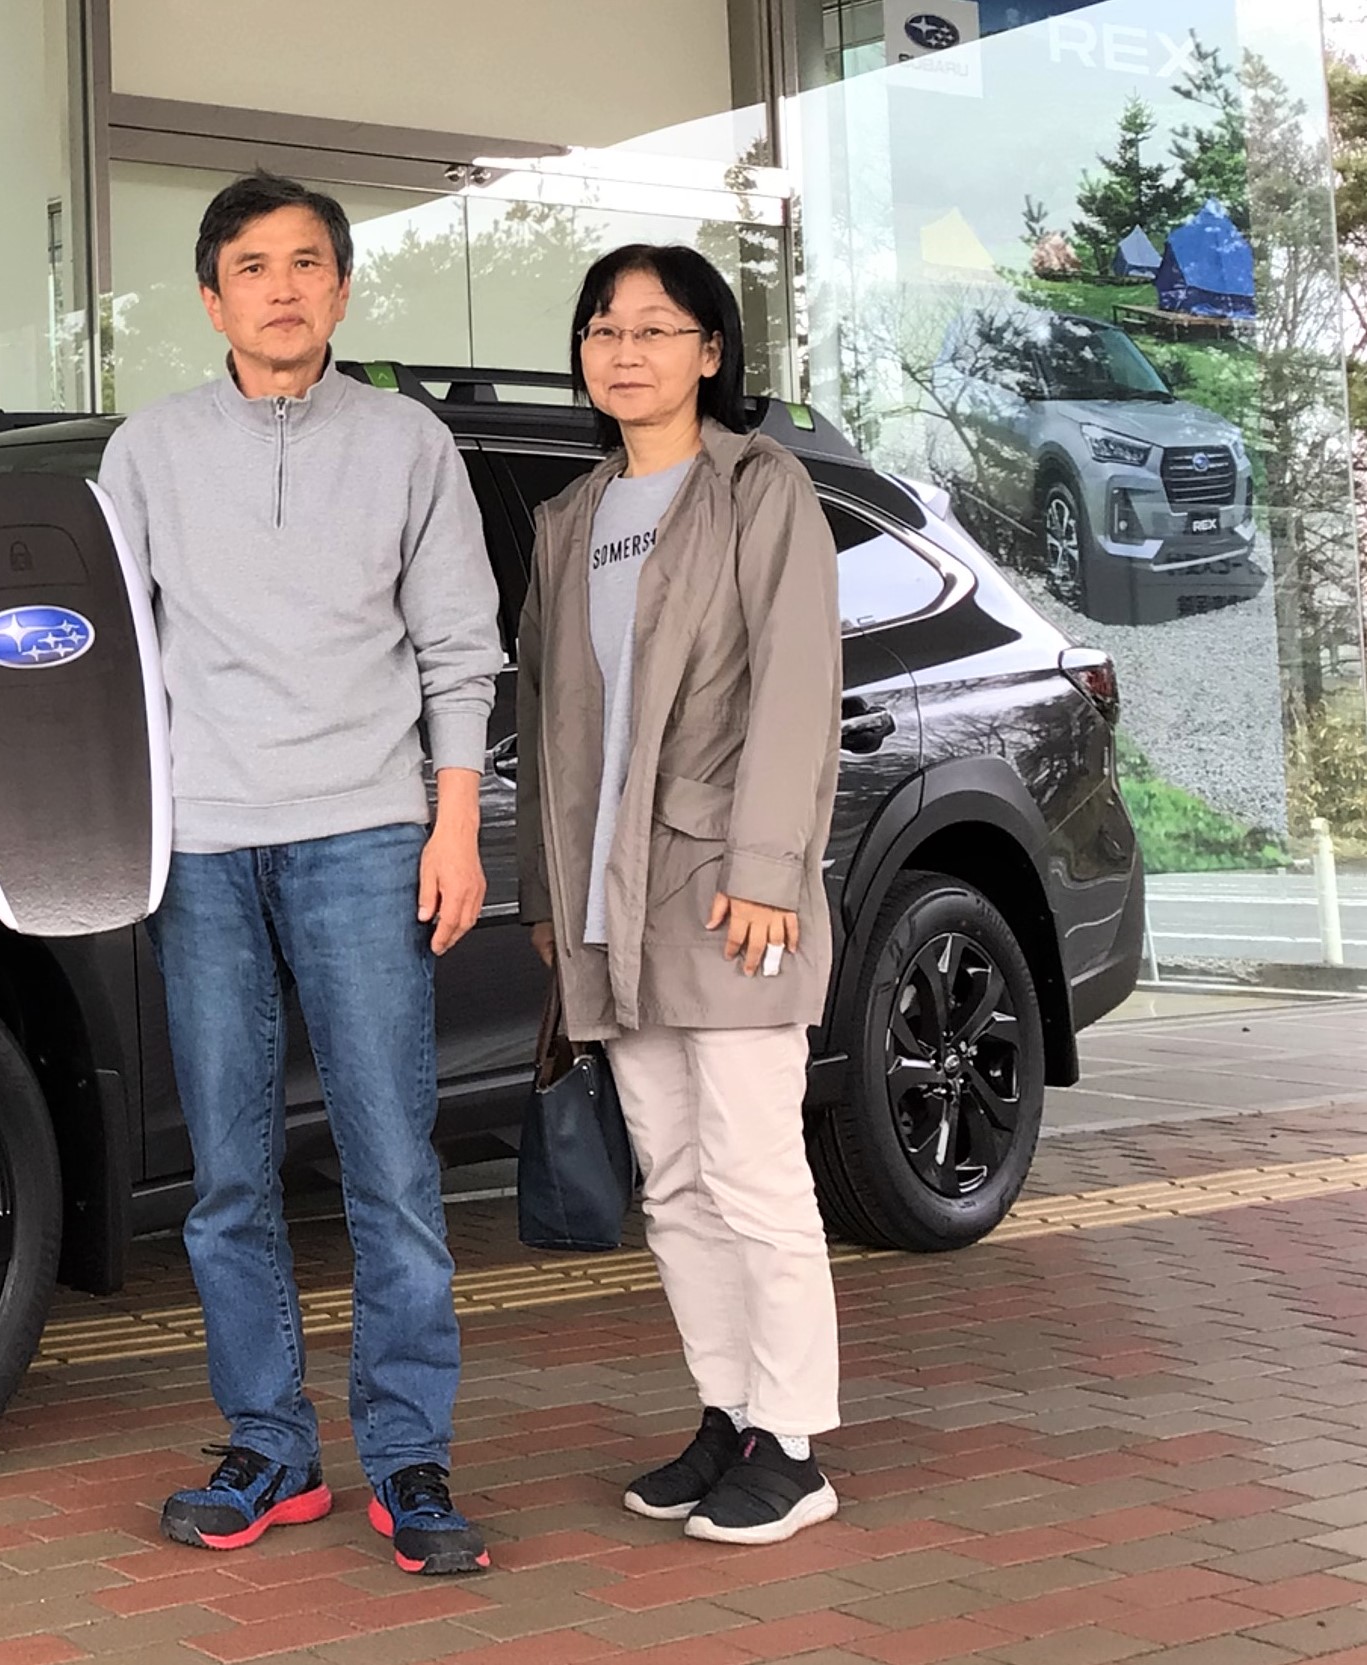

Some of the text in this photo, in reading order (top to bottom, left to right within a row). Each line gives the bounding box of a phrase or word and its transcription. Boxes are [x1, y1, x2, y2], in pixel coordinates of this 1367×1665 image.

[1047, 16, 1201, 78] REX
[898, 52, 969, 78] SUBARU
[1192, 518, 1217, 532] REX
